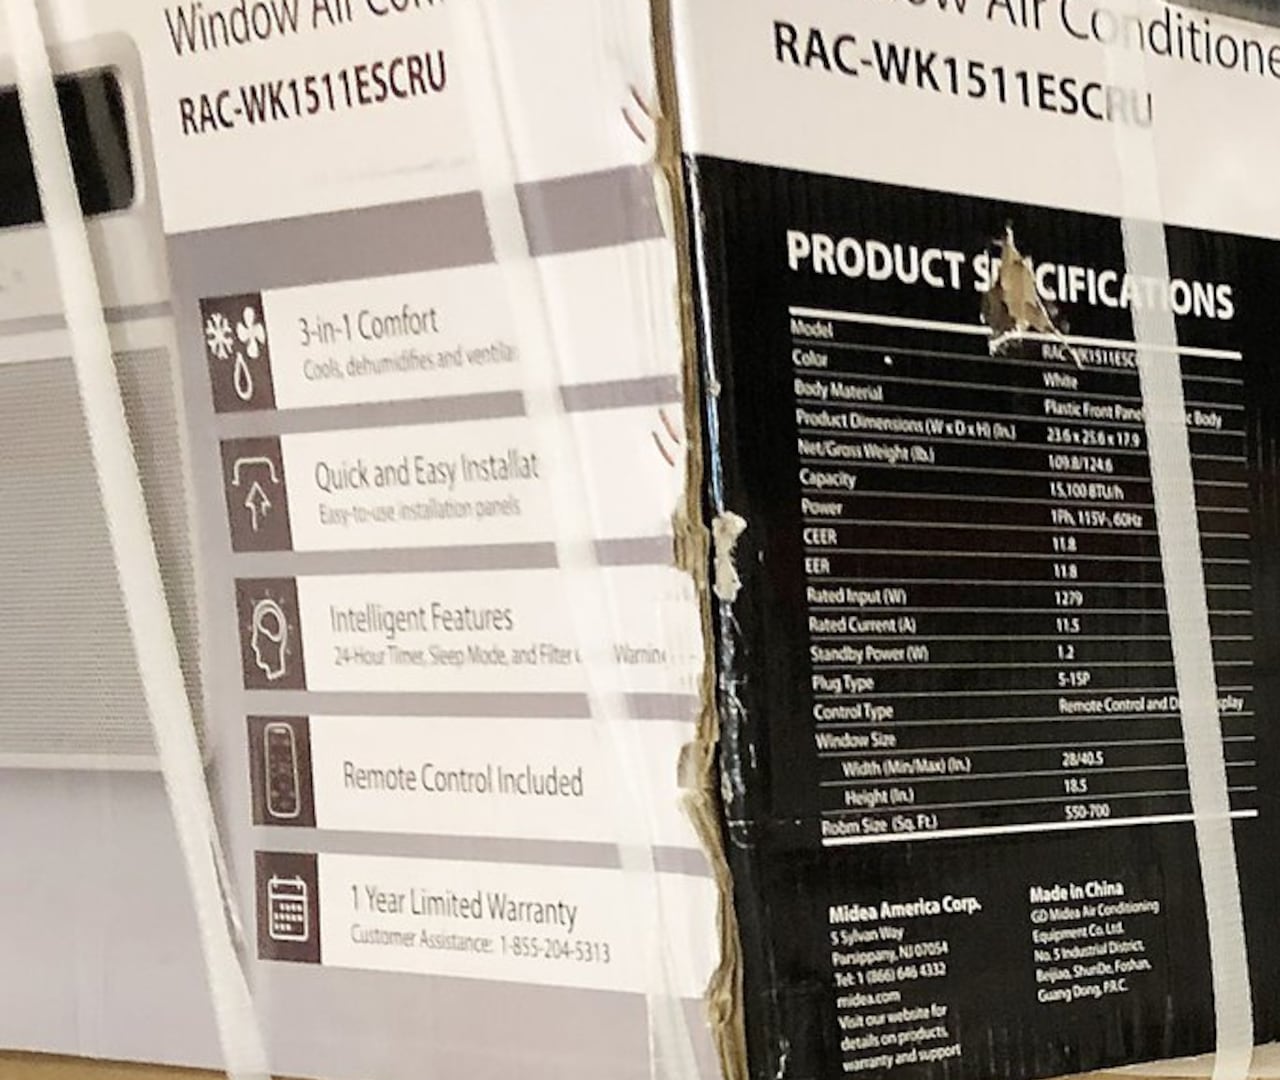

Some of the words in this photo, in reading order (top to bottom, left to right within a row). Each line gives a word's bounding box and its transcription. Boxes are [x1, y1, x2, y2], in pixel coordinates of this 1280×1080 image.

[179, 50, 447, 136] RAC-WK1511ESCRU
[787, 230, 965, 289] PRODUCT
[300, 316, 353, 346] 3-in-1
[358, 306, 439, 340] Comfort
[314, 460, 370, 492] Quick
[373, 458, 408, 487] and
[413, 455, 457, 493] Easy
[800, 469, 856, 491] Capacity
[330, 604, 425, 639] Intelligent
[431, 602, 512, 631] Features
[344, 761, 414, 792] Remote
[421, 764, 492, 794] Control
[498, 766, 583, 798] Included
[364, 885, 405, 915] Year
[411, 888, 482, 920] Limited
[489, 892, 577, 932] Warranty
[829, 905, 877, 925] Midea
[881, 900, 941, 920] America
[944, 896, 981, 918] Corp.
[1030, 886, 1067, 904] Made
[1071, 884, 1083, 900] in
[1086, 880, 1123, 899] China
[350, 924, 415, 949] Customer
[500, 934, 610, 964] 1-855-204-5313
